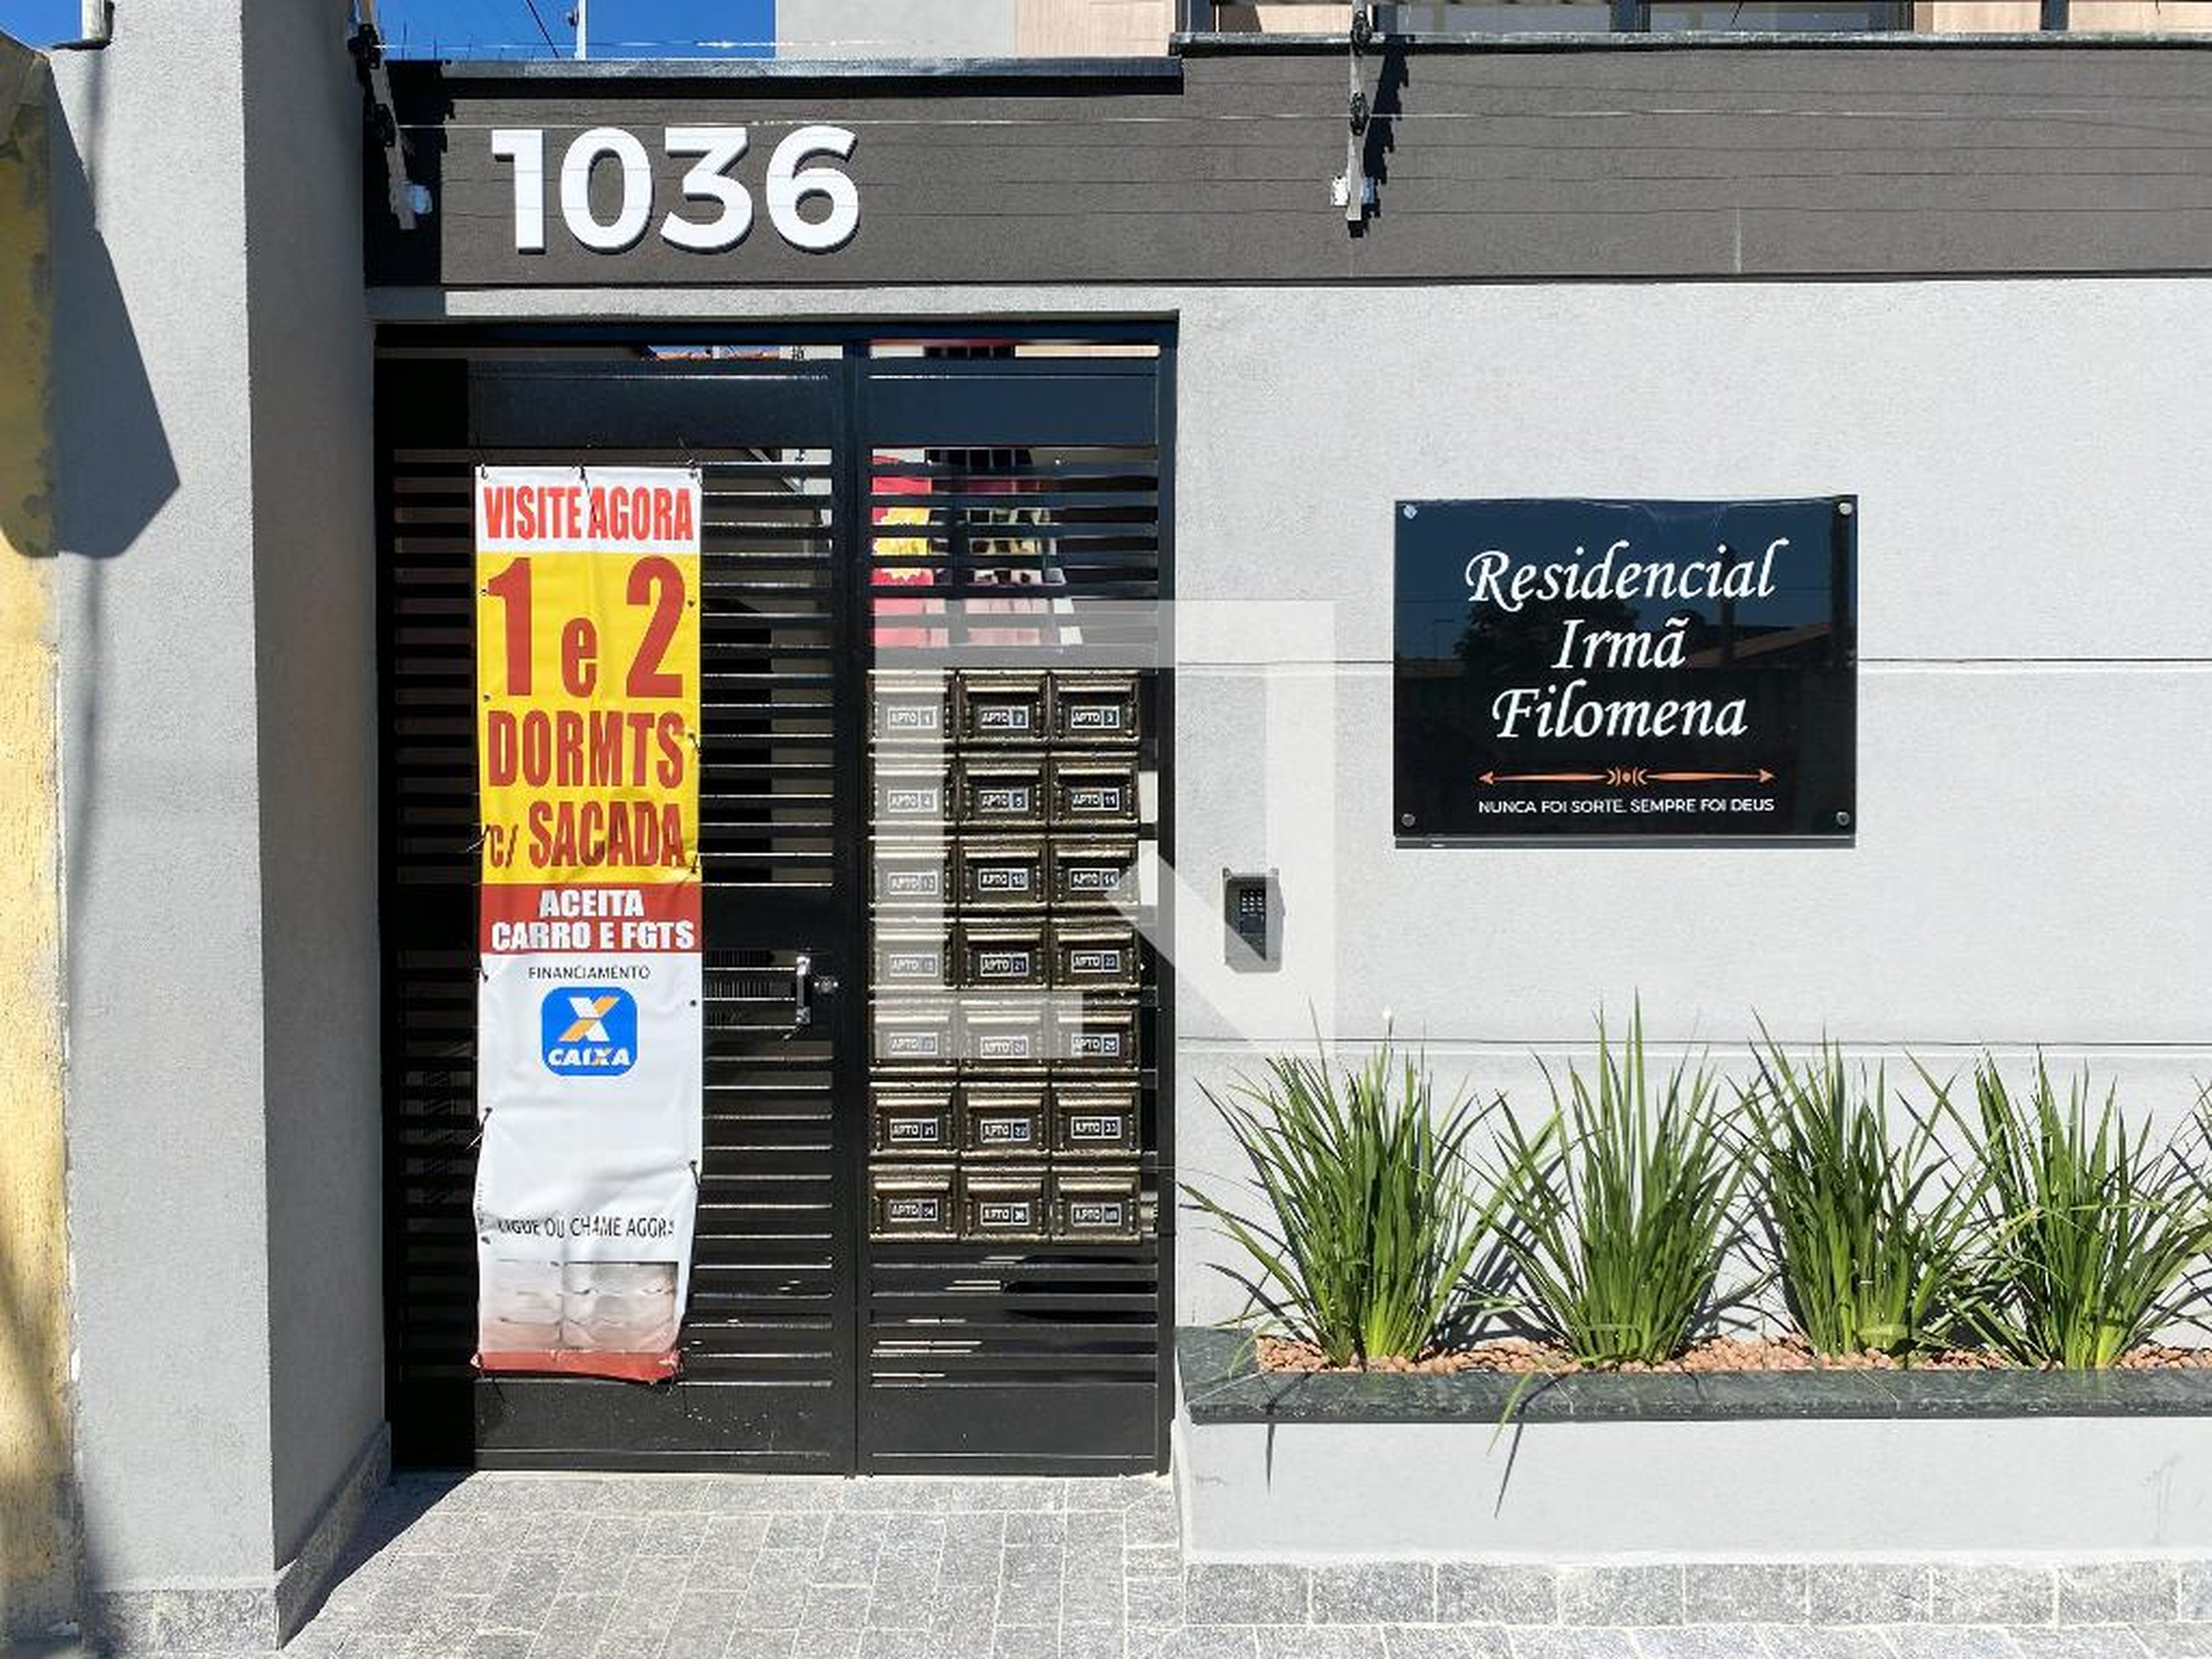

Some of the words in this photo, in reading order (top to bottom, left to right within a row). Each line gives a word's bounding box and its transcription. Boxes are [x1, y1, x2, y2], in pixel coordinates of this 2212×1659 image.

[490, 125, 859, 254] 1036
[483, 486, 582, 539] VISITE
[588, 486, 694, 540] AGORA
[1464, 538, 1789, 612] Residencial
[487, 557, 532, 696] 1
[561, 617, 597, 698] e
[626, 556, 685, 698] 2
[1551, 617, 1687, 669] Irmã
[1492, 679, 1748, 738] Filomena
[891, 712, 917, 723] APTO
[982, 712, 1009, 723] APTO
[1073, 711, 1100, 722] APTO
[487, 711, 685, 789] DORMTS
[891, 794, 917, 806] APTO
[982, 795, 1009, 806] APTO
[1073, 794, 1100, 805] APTO
[1479, 801, 1537, 813] NUNCA
[1541, 800, 1567, 813] FOI
[1630, 799, 1696, 812] SEMPRE
[1700, 798, 1726, 812] FOI
[1730, 798, 1775, 811] DEUS
[529, 801, 686, 868] SACADA
[891, 878, 918, 889] APTO
[983, 875, 1007, 884] APTO
[1073, 874, 1099, 885] APTO
[539, 890, 643, 917] ACEITA
[491, 922, 591, 949] CARRO
[600, 923, 615, 949] E
[622, 921, 695, 949] FGTS
[891, 960, 919, 970] APTO
[982, 960, 1009, 970] APTO
[1074, 956, 1100, 967] APTO
[529, 966, 651, 979] FINANCIAMENTO
[892, 1039, 918, 1049] APTO
[983, 1041, 1010, 1052] APTO
[1073, 1038, 1100, 1048] APTO
[548, 1047, 630, 1067] CAIXA
[892, 1124, 919, 1134] APTO
[983, 1126, 1009, 1135] APTO
[1075, 1123, 1100, 1133] APTO
[892, 1205, 918, 1215] APTO
[983, 1209, 1009, 1219] APTO
[1075, 1210, 1100, 1221] APTO
[544, 1217, 566, 1238] OU
[569, 1217, 622, 1237] CHAME
